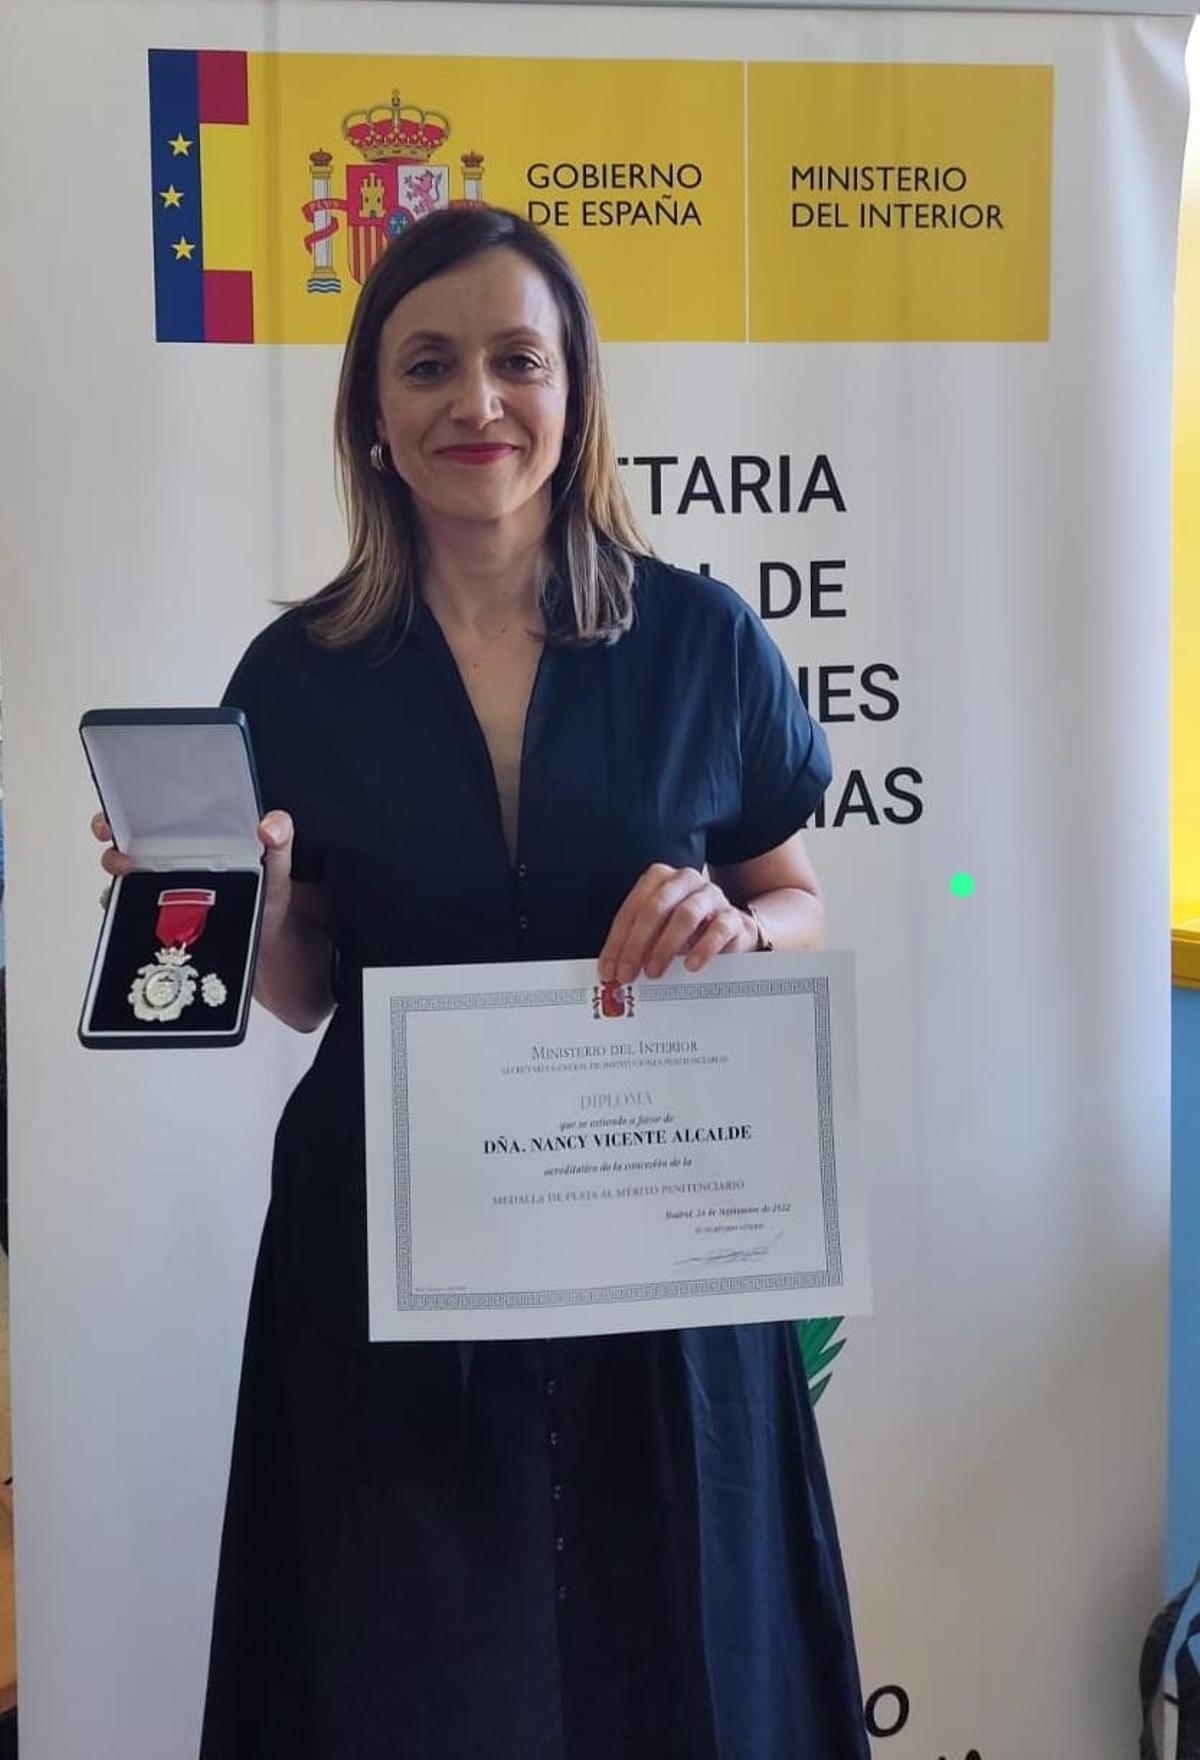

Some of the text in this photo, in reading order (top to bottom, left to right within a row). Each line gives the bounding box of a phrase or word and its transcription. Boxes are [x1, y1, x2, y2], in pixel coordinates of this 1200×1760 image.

[527, 163, 702, 189] GOBIERNO
[791, 165, 967, 192] MINISTERIO
[527, 194, 702, 227] DE ESPAÑA
[791, 203, 1004, 230] DEL INTERIOR
[617, 454, 847, 515] TARIA
[759, 560, 847, 620] DE
[532, 1039, 699, 1061] MINISTERIO DEL INTERIOR
[579, 1091, 654, 1111] DIPLOMA
[483, 1124, 753, 1155] DÑA. NANCY VICENTE ALCALDE
